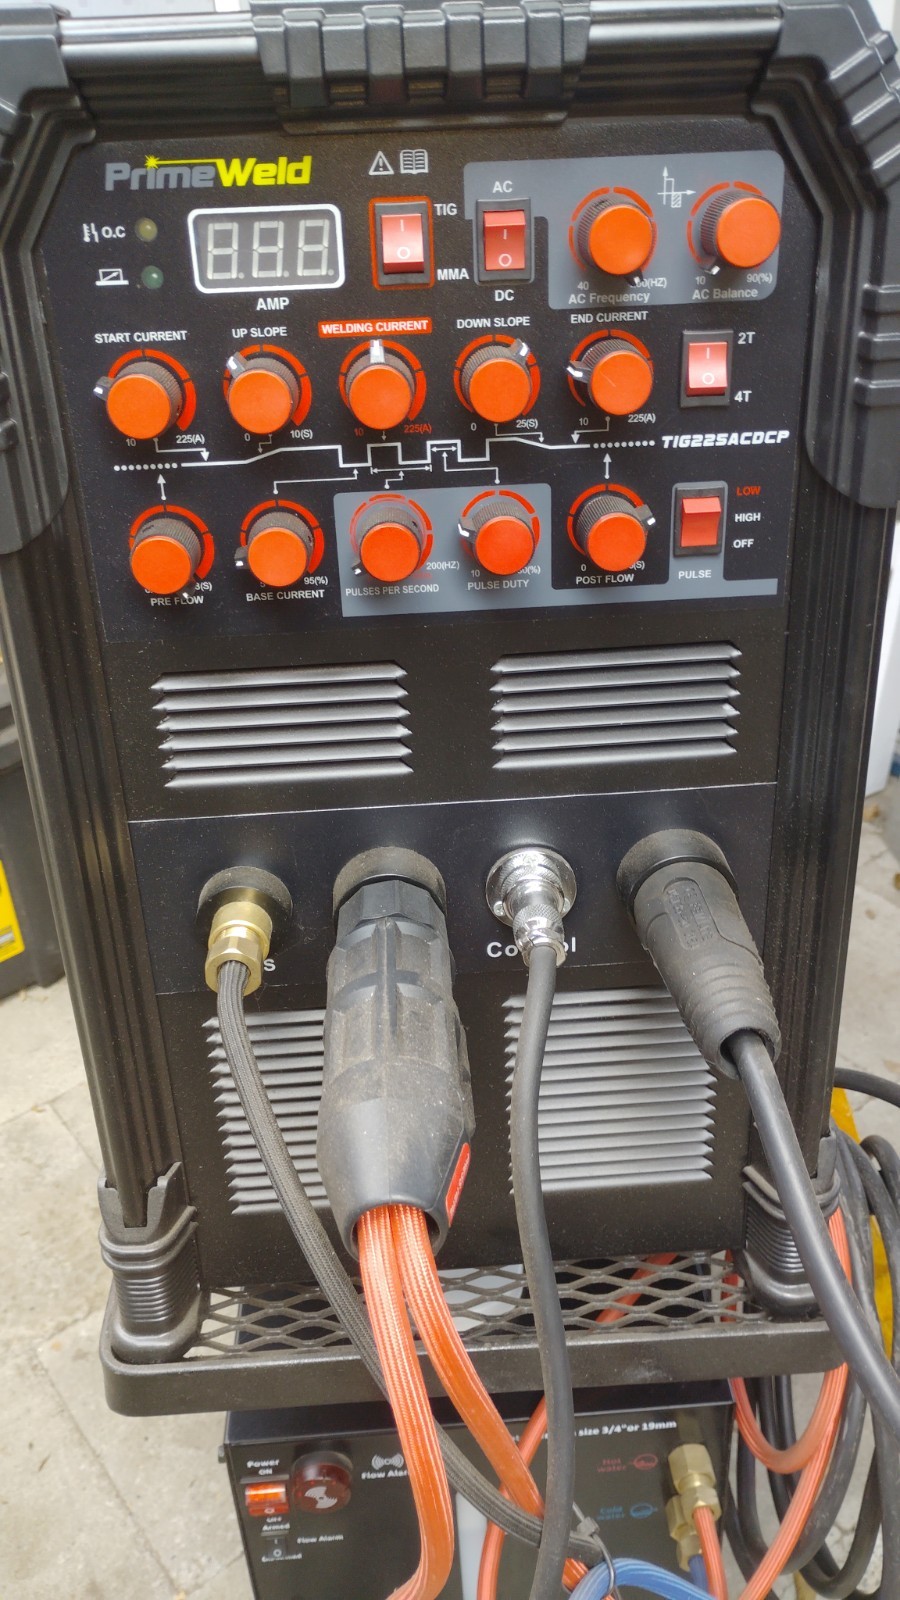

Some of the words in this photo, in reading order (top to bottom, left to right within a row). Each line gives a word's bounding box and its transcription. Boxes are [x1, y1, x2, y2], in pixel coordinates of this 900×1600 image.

[105, 155, 312, 191] PrimeWeld
[492, 181, 513, 193] AC
[434, 203, 457, 216] TIG
[437, 268, 469, 281] MMA
[747, 273, 773, 284] 90(%)
[577, 281, 589, 290] 40
[695, 276, 706, 285] 10
[494, 289, 515, 301] DC
[568, 293, 586, 304] AC
[589, 291, 650, 306] Frequency
[692, 289, 710, 300] AC
[713, 287, 758, 299] Balance
[256, 297, 290, 311] AMP
[456, 318, 491, 329] DOWN
[494, 316, 531, 327] SLOPE
[570, 313, 593, 324] END
[596, 311, 649, 323] CURRENT
[321, 322, 373, 334] WELDING
[375, 320, 429, 332] CURRENT
[95, 332, 131, 344] START
[133, 330, 188, 342] CURRENT
[232, 328, 248, 339] UP
[250, 327, 288, 338] SLOPE
[737, 332, 756, 344] 2T
[734, 390, 752, 402] 4T
[516, 418, 539, 429] 25(S)
[579, 417, 589, 426] 10
[627, 413, 656, 424] 225(A)
[404, 424, 432, 435] 225(A)
[470, 422, 477, 431] 0
[244, 433, 251, 442] 0
[290, 429, 313, 440] 10(S)
[354, 428, 364, 437] 10
[125, 438, 137, 447] 10
[175, 434, 205, 445] 225(A)
[662, 430, 790, 448] TIG225ACDCP
[736, 486, 761, 496] LOW
[734, 512, 761, 522] HIGH
[733, 539, 754, 549] OFF
[426, 561, 460, 571] 200(HZ)
[581, 563, 587, 572] 0
[470, 569, 480, 578] 10
[576, 575, 602, 585] POST
[605, 573, 635, 583] FLOW
[678, 569, 712, 579] PULSE
[304, 576, 328, 586] 95(%)
[467, 581, 500, 591] PULSE
[502, 579, 530, 589] DUTY
[345, 587, 380, 596] PULSES
[382, 586, 400, 594] PER
[402, 583, 440, 594] SECOND
[151, 598, 171, 607] PRE
[174, 596, 204, 605] FLOW
[246, 593, 273, 602] BASE
[278, 590, 325, 600] CURRENT
[578, 1427, 599, 1437] size
[641, 1420, 677, 1431] 19mm
[246, 1459, 280, 1469] Power
[361, 1471, 386, 1480] Flow
[388, 1468, 410, 1478] Alar
